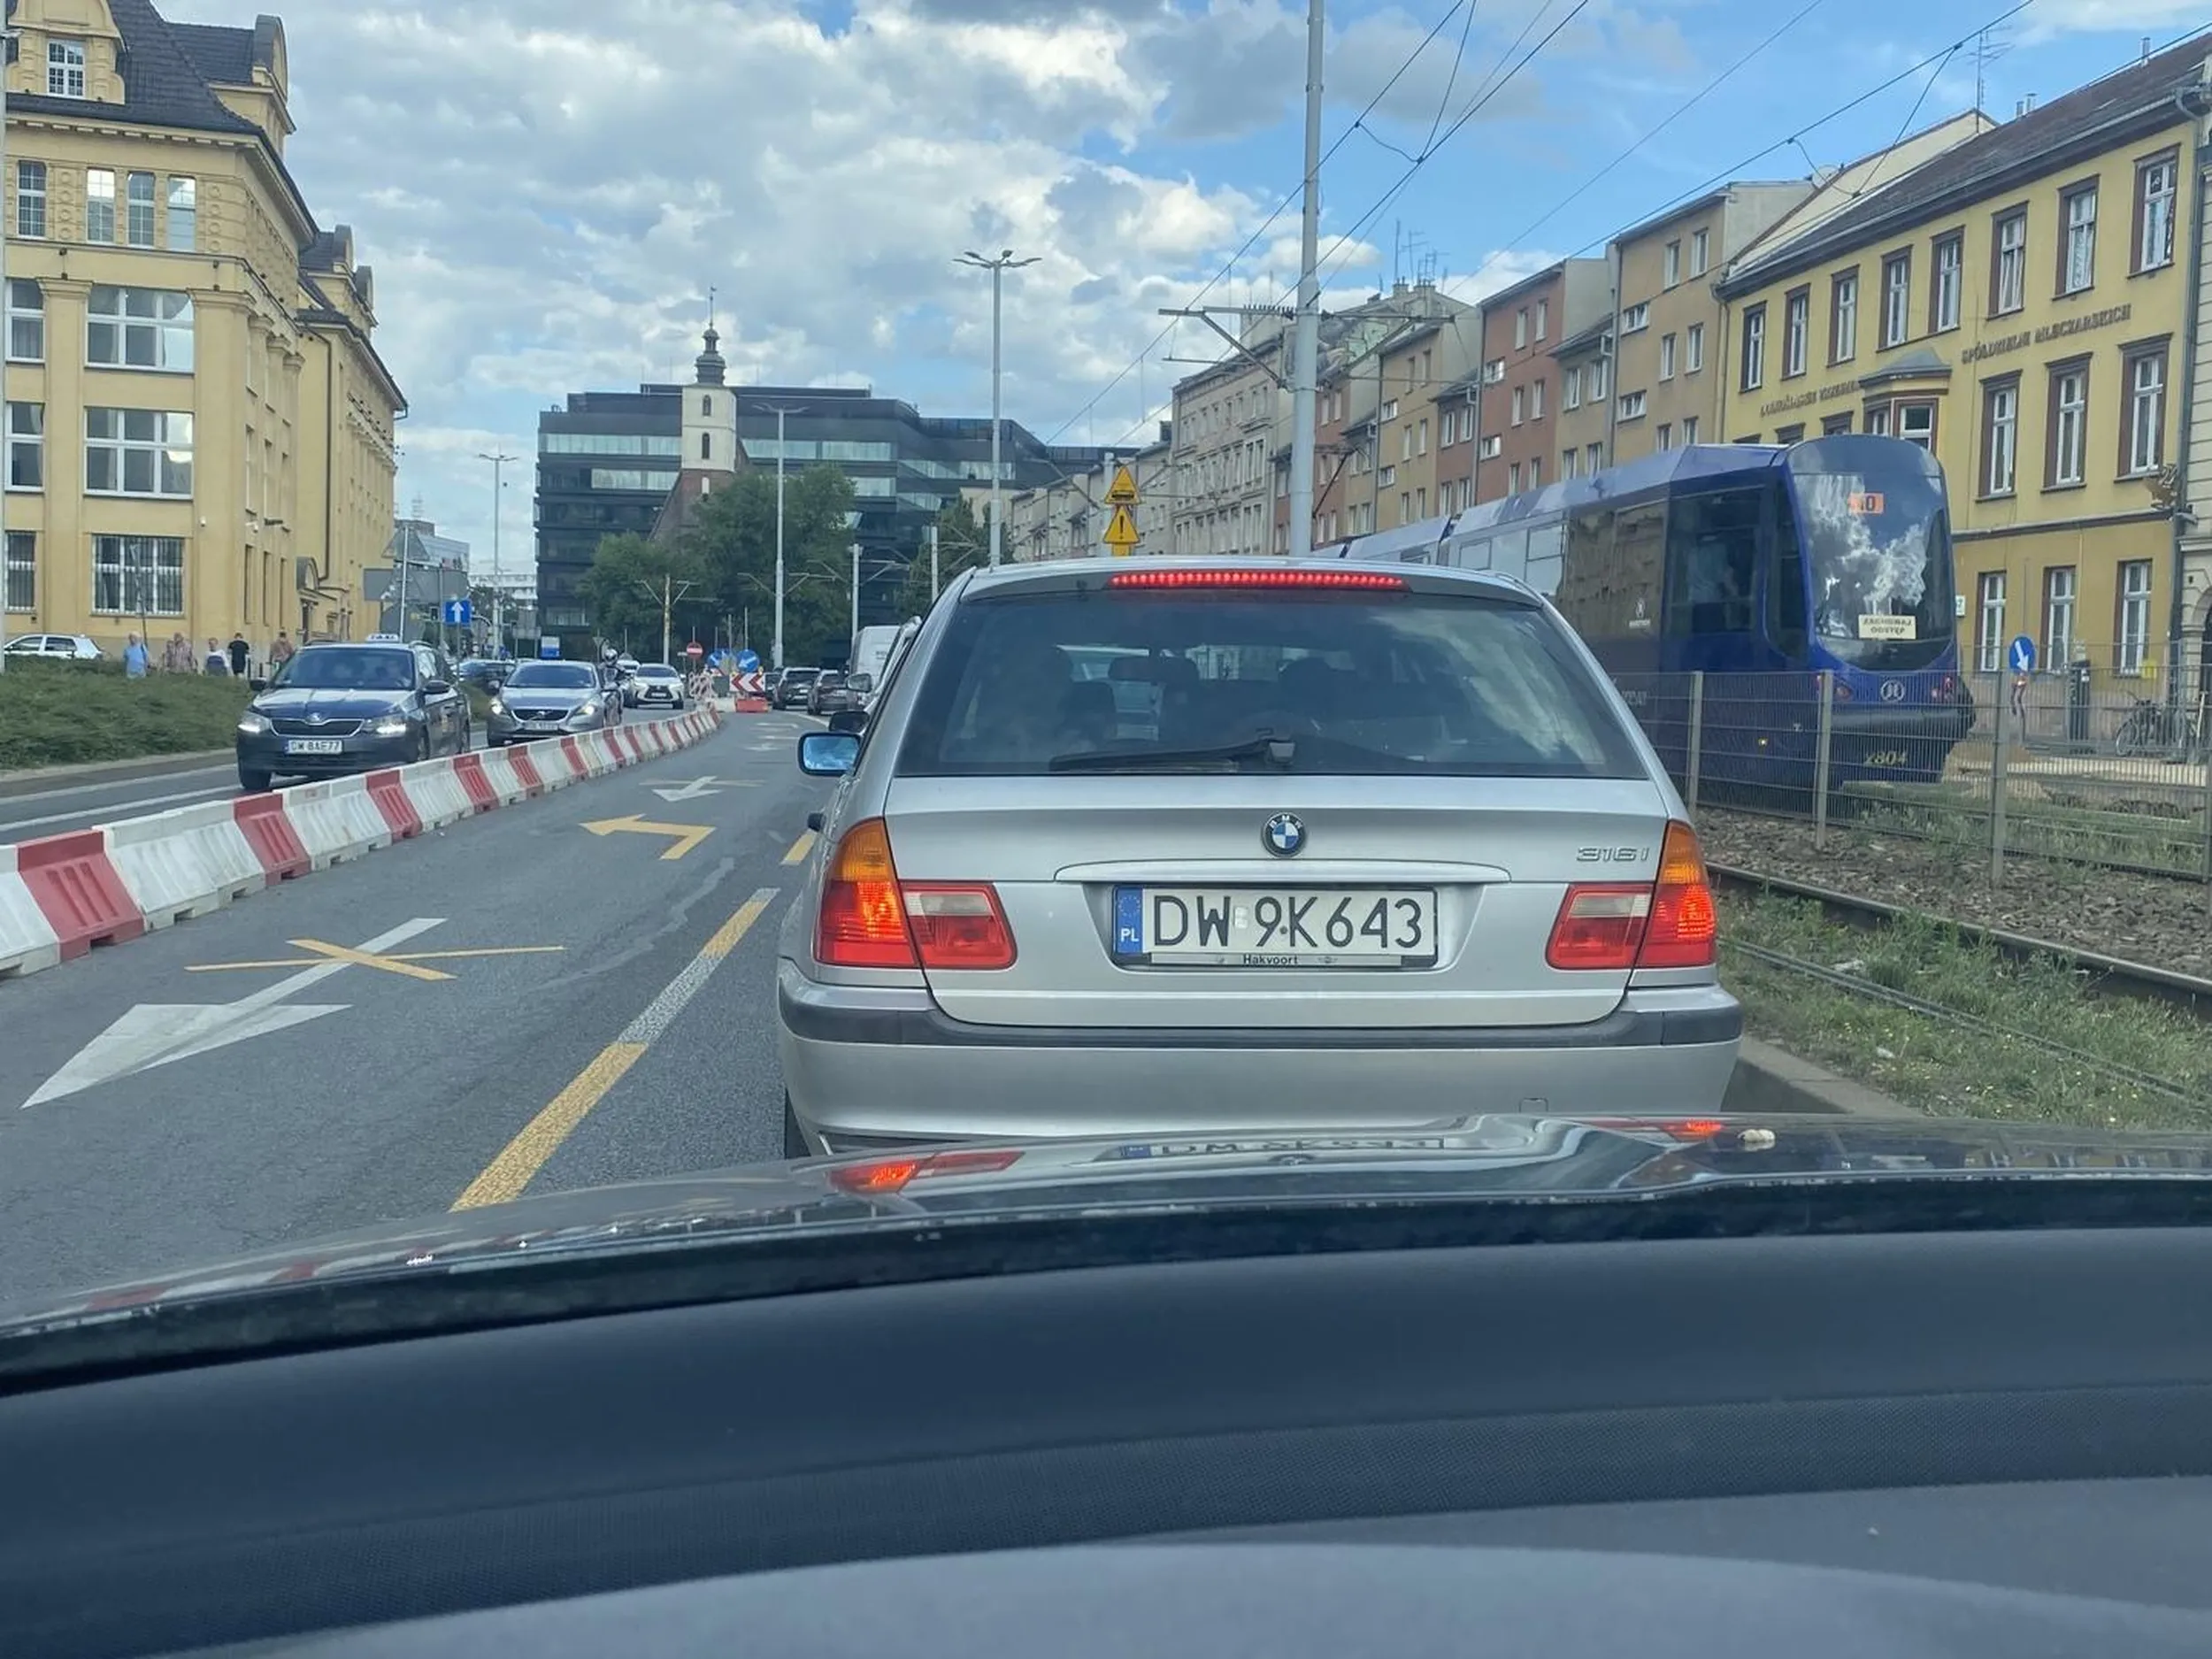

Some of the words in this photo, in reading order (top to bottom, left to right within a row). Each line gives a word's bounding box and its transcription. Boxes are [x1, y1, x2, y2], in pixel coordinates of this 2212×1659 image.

[1269, 815, 1302, 828] BMW
[1120, 928, 1140, 942] PL
[1242, 954, 1298, 965] Hakvoort
